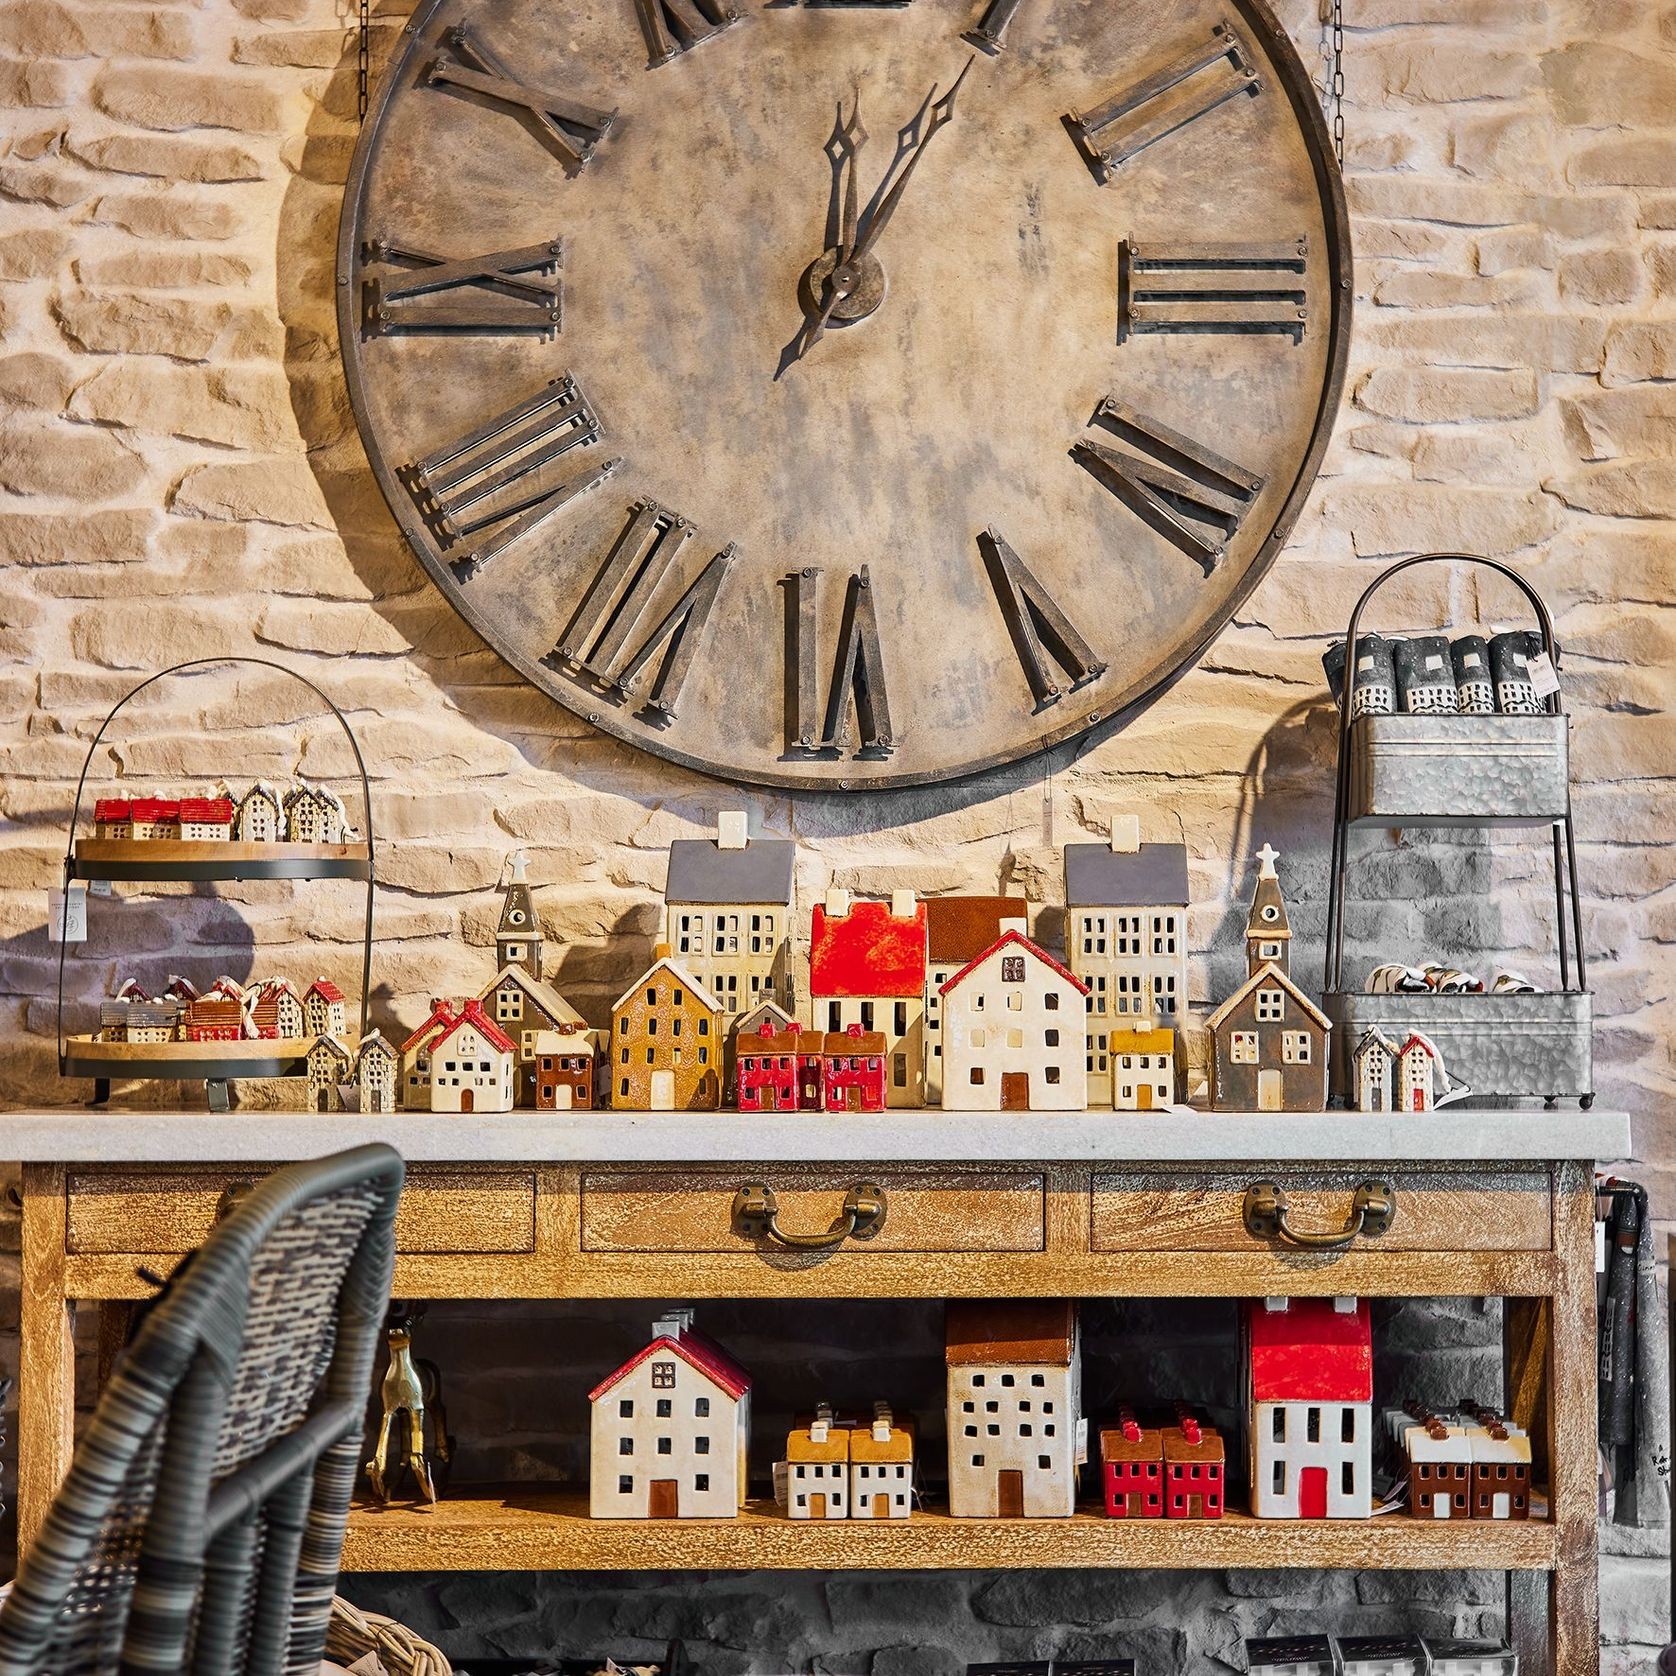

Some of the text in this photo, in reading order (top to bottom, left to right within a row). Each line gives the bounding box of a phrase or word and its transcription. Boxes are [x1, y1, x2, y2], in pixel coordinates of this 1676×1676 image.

[428, 20, 620, 174] X
[1069, 19, 1264, 182] II
[376, 232, 565, 336] IX
[1128, 232, 1307, 338] III
[417, 369, 625, 573] VIII
[1076, 395, 1270, 562] IV
[552, 496, 739, 720] VII
[790, 564, 900, 749] VI
[986, 523, 1109, 702] V
